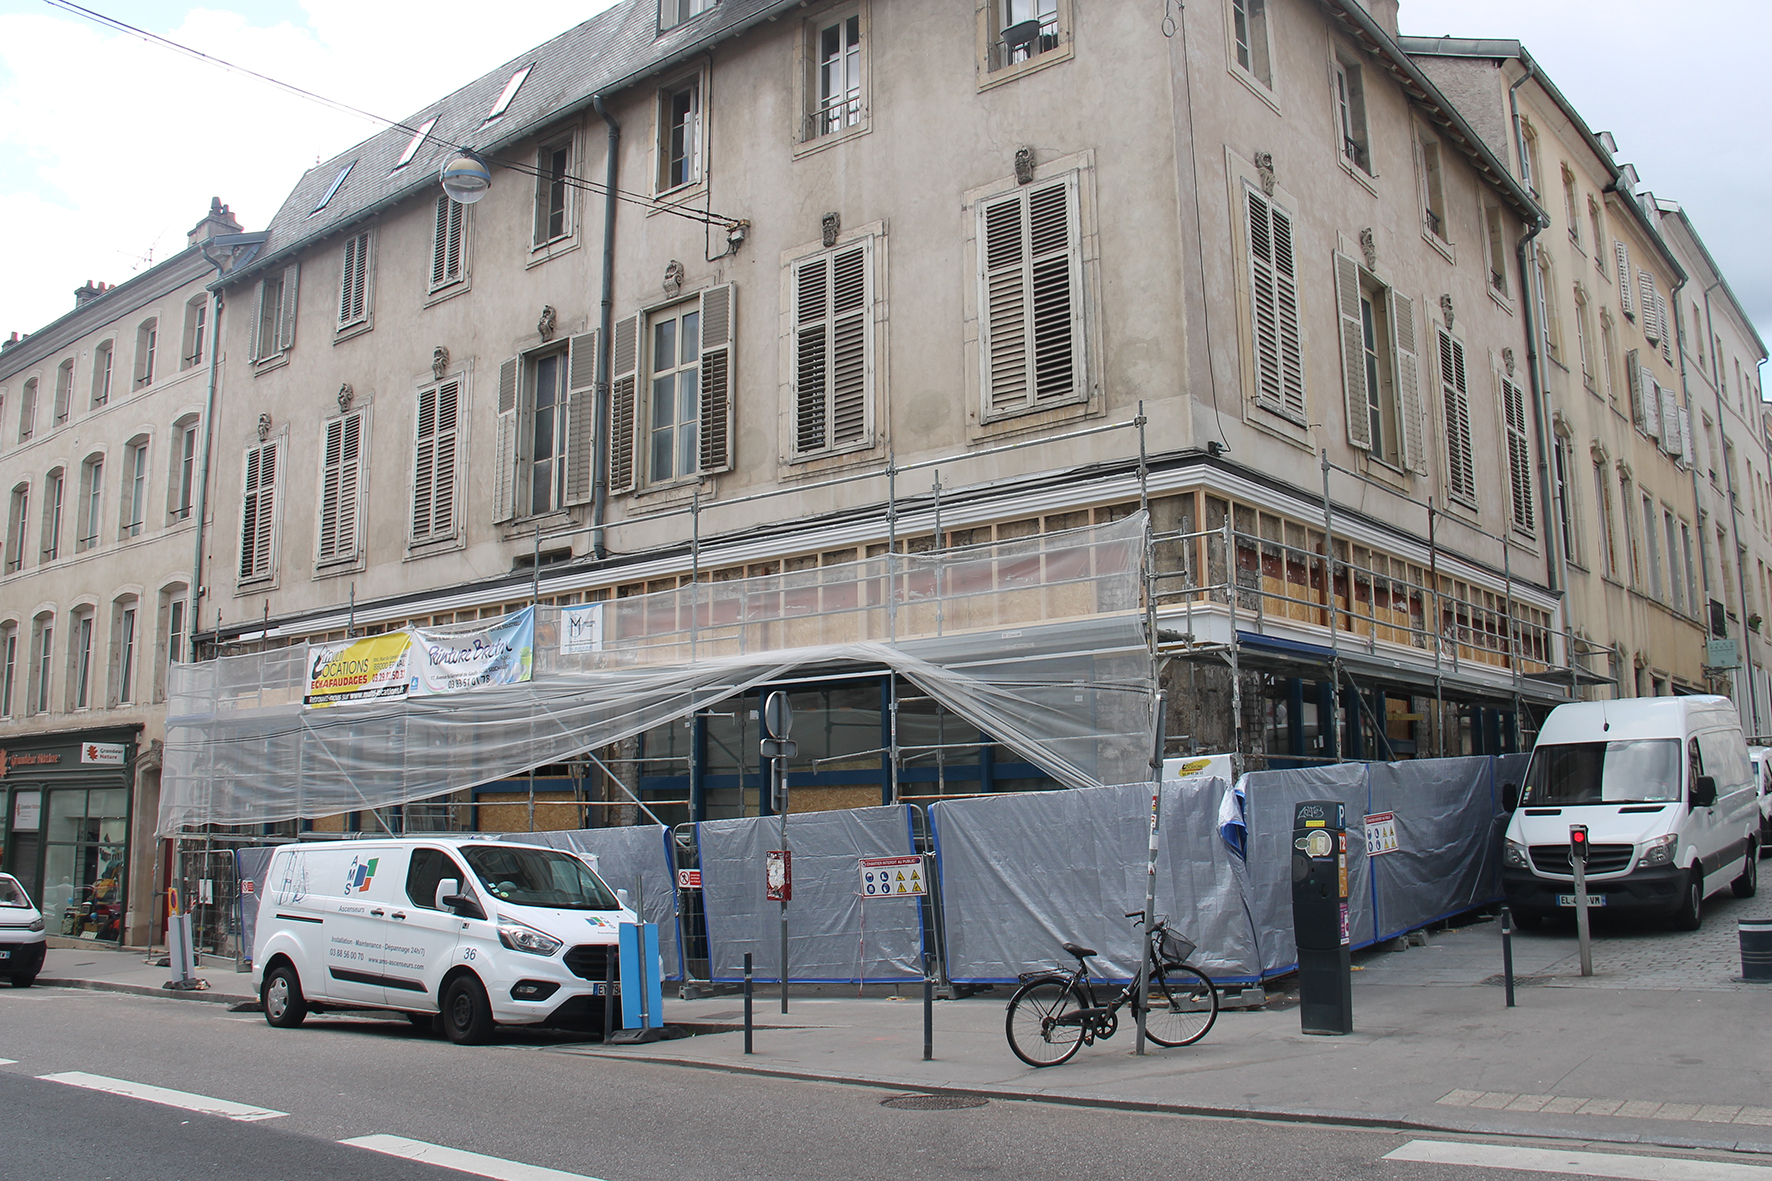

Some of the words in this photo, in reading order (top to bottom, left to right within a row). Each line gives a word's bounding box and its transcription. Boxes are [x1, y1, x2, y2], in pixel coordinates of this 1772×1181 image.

[448, 680, 454, 689] 03
[456, 679, 462, 688] 83
[464, 678, 470, 687] 51
[480, 674, 490, 684] 78
[1338, 804, 1344, 826] P
[338, 905, 365, 913] Ascenseurs
[331, 936, 353, 945] Installation
[356, 940, 381, 949] Maintenance
[384, 943, 410, 954] Dépannage
[330, 948, 336, 956] 03
[337, 949, 343, 957] 88
[344, 950, 349, 958] 56
[350, 951, 357, 960] 00
[368, 957, 424, 970] www.ams-ascenseurs.com
[464, 947, 477, 960] 36
